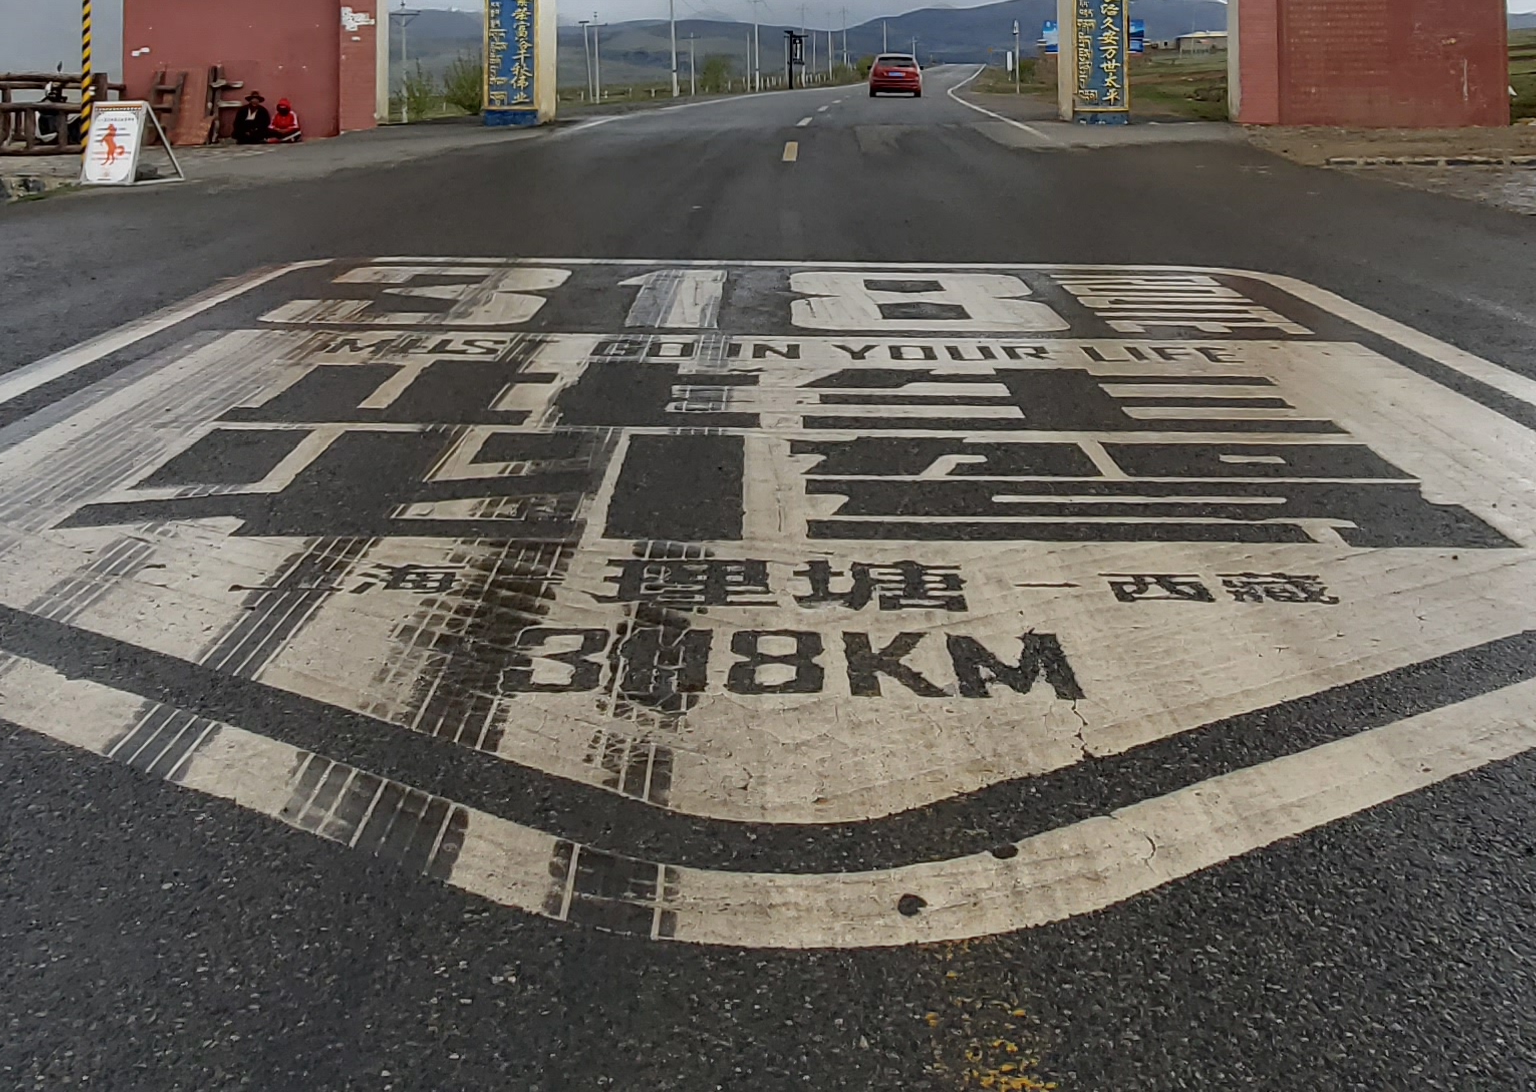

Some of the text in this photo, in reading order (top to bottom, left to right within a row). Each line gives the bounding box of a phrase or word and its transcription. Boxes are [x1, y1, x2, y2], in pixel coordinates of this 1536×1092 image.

[256, 266, 1072, 331] 318
[1049, 273, 1316, 335] ROUTE
[590, 340, 696, 357] GO
[832, 344, 1051, 362] YOUR
[1079, 346, 1248, 364] LIFE
[214, 360, 1351, 434] 此生
[52, 427, 1522, 549] 必驾
[594, 558, 968, 611] 理塘
[1098, 572, 1340, 605] 西藏
